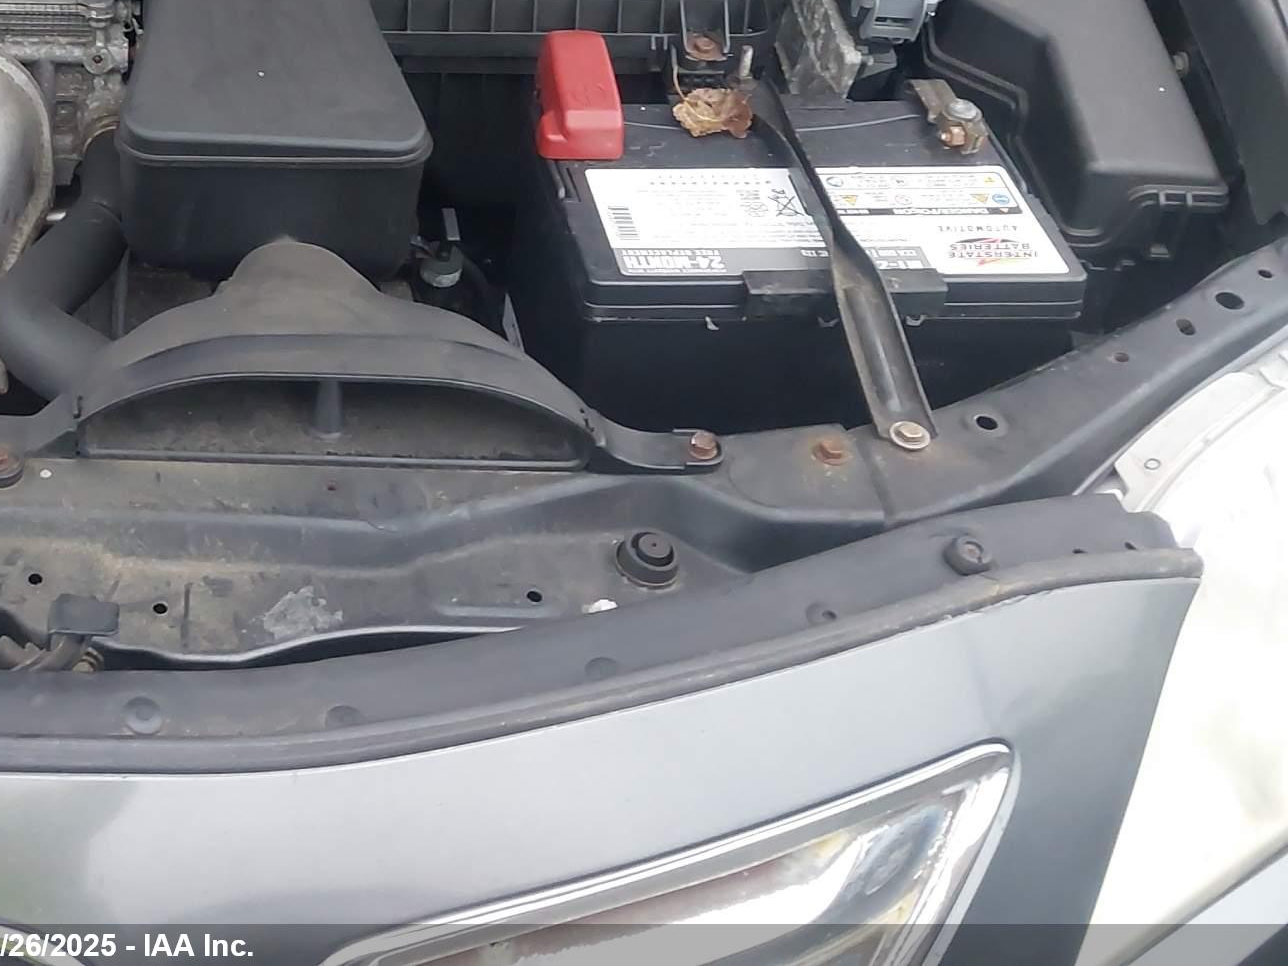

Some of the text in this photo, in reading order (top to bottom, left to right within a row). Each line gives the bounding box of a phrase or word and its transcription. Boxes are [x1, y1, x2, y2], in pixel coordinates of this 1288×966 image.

[949, 242, 1031, 251] BATTERIES
[948, 250, 1040, 259] INTERSTATE
[622, 255, 727, 269] 24-MONTH
